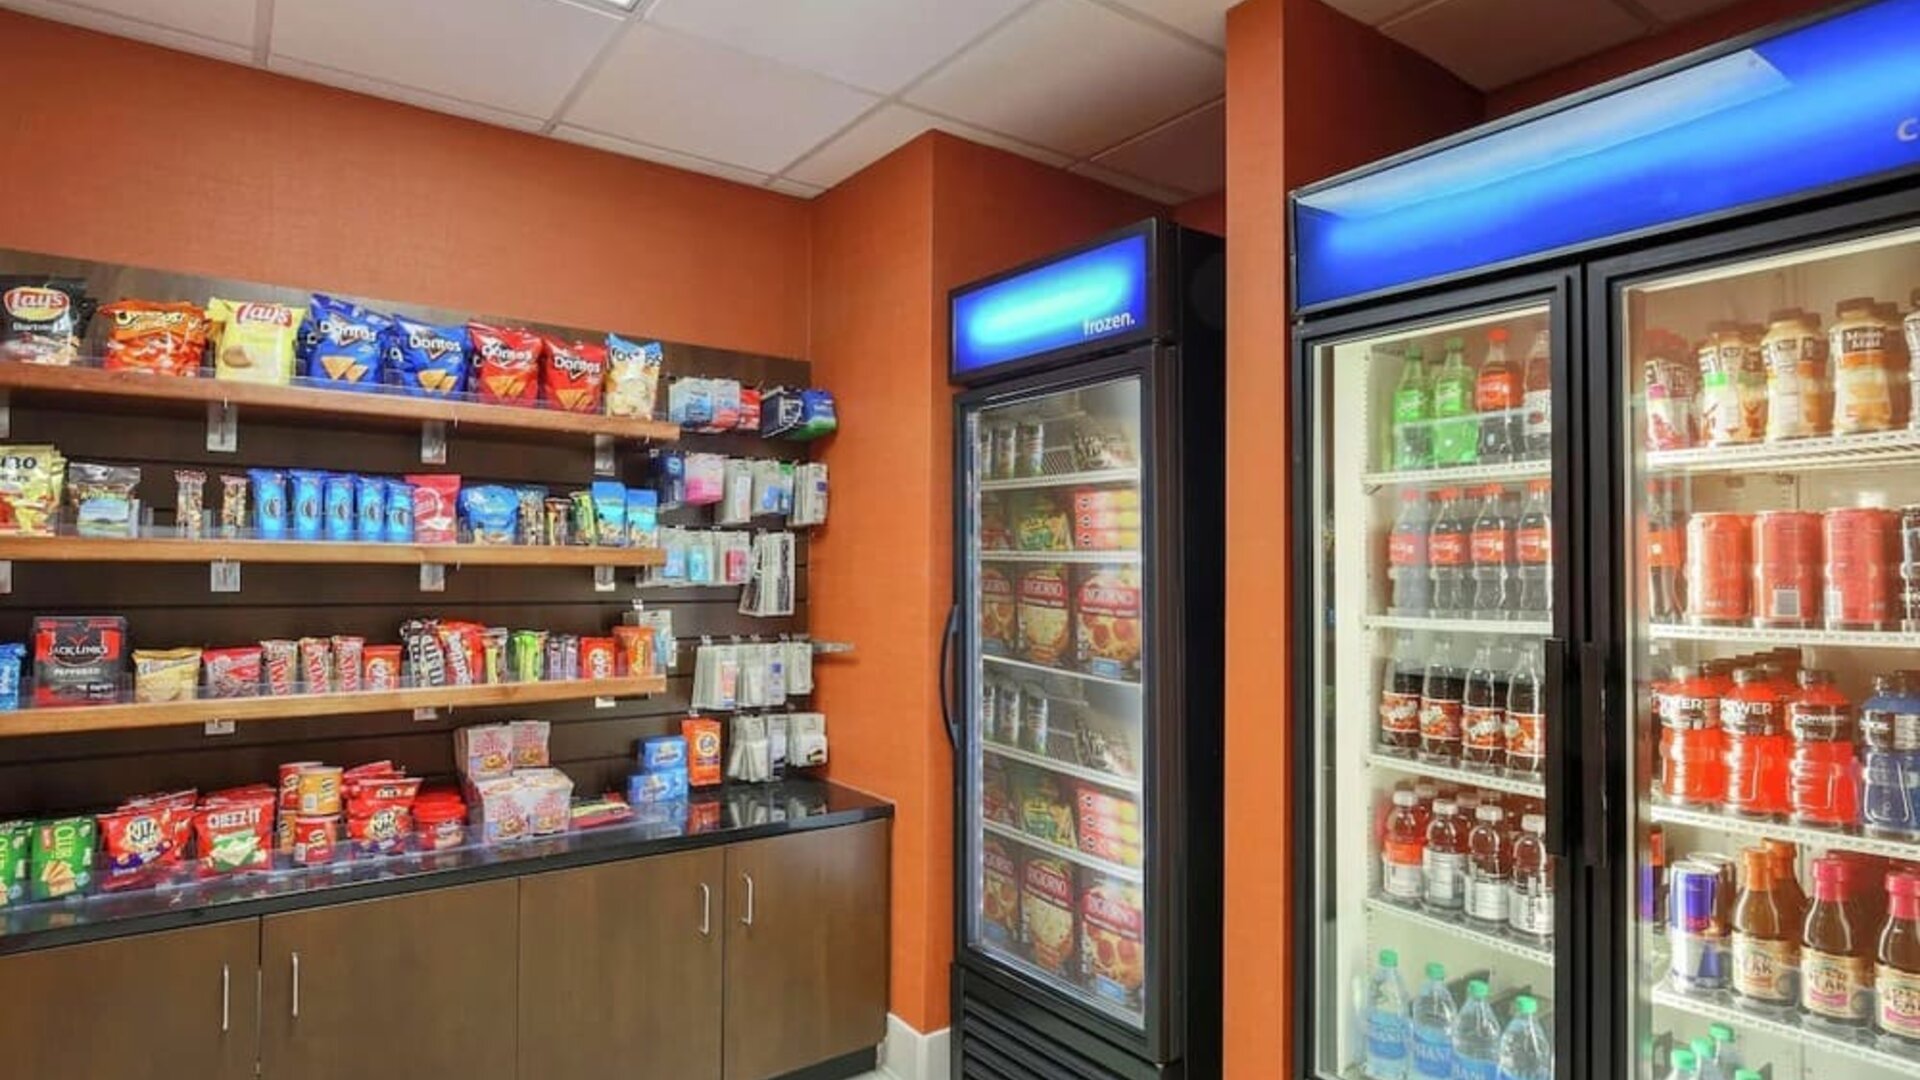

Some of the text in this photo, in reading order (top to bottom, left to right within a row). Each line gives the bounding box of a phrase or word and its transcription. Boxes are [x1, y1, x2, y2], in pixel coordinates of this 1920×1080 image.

[320, 319, 376, 344] Doritos
[408, 333, 462, 353] Doritos
[482, 343, 533, 364] Doritos
[553, 354, 601, 373] Doritos
